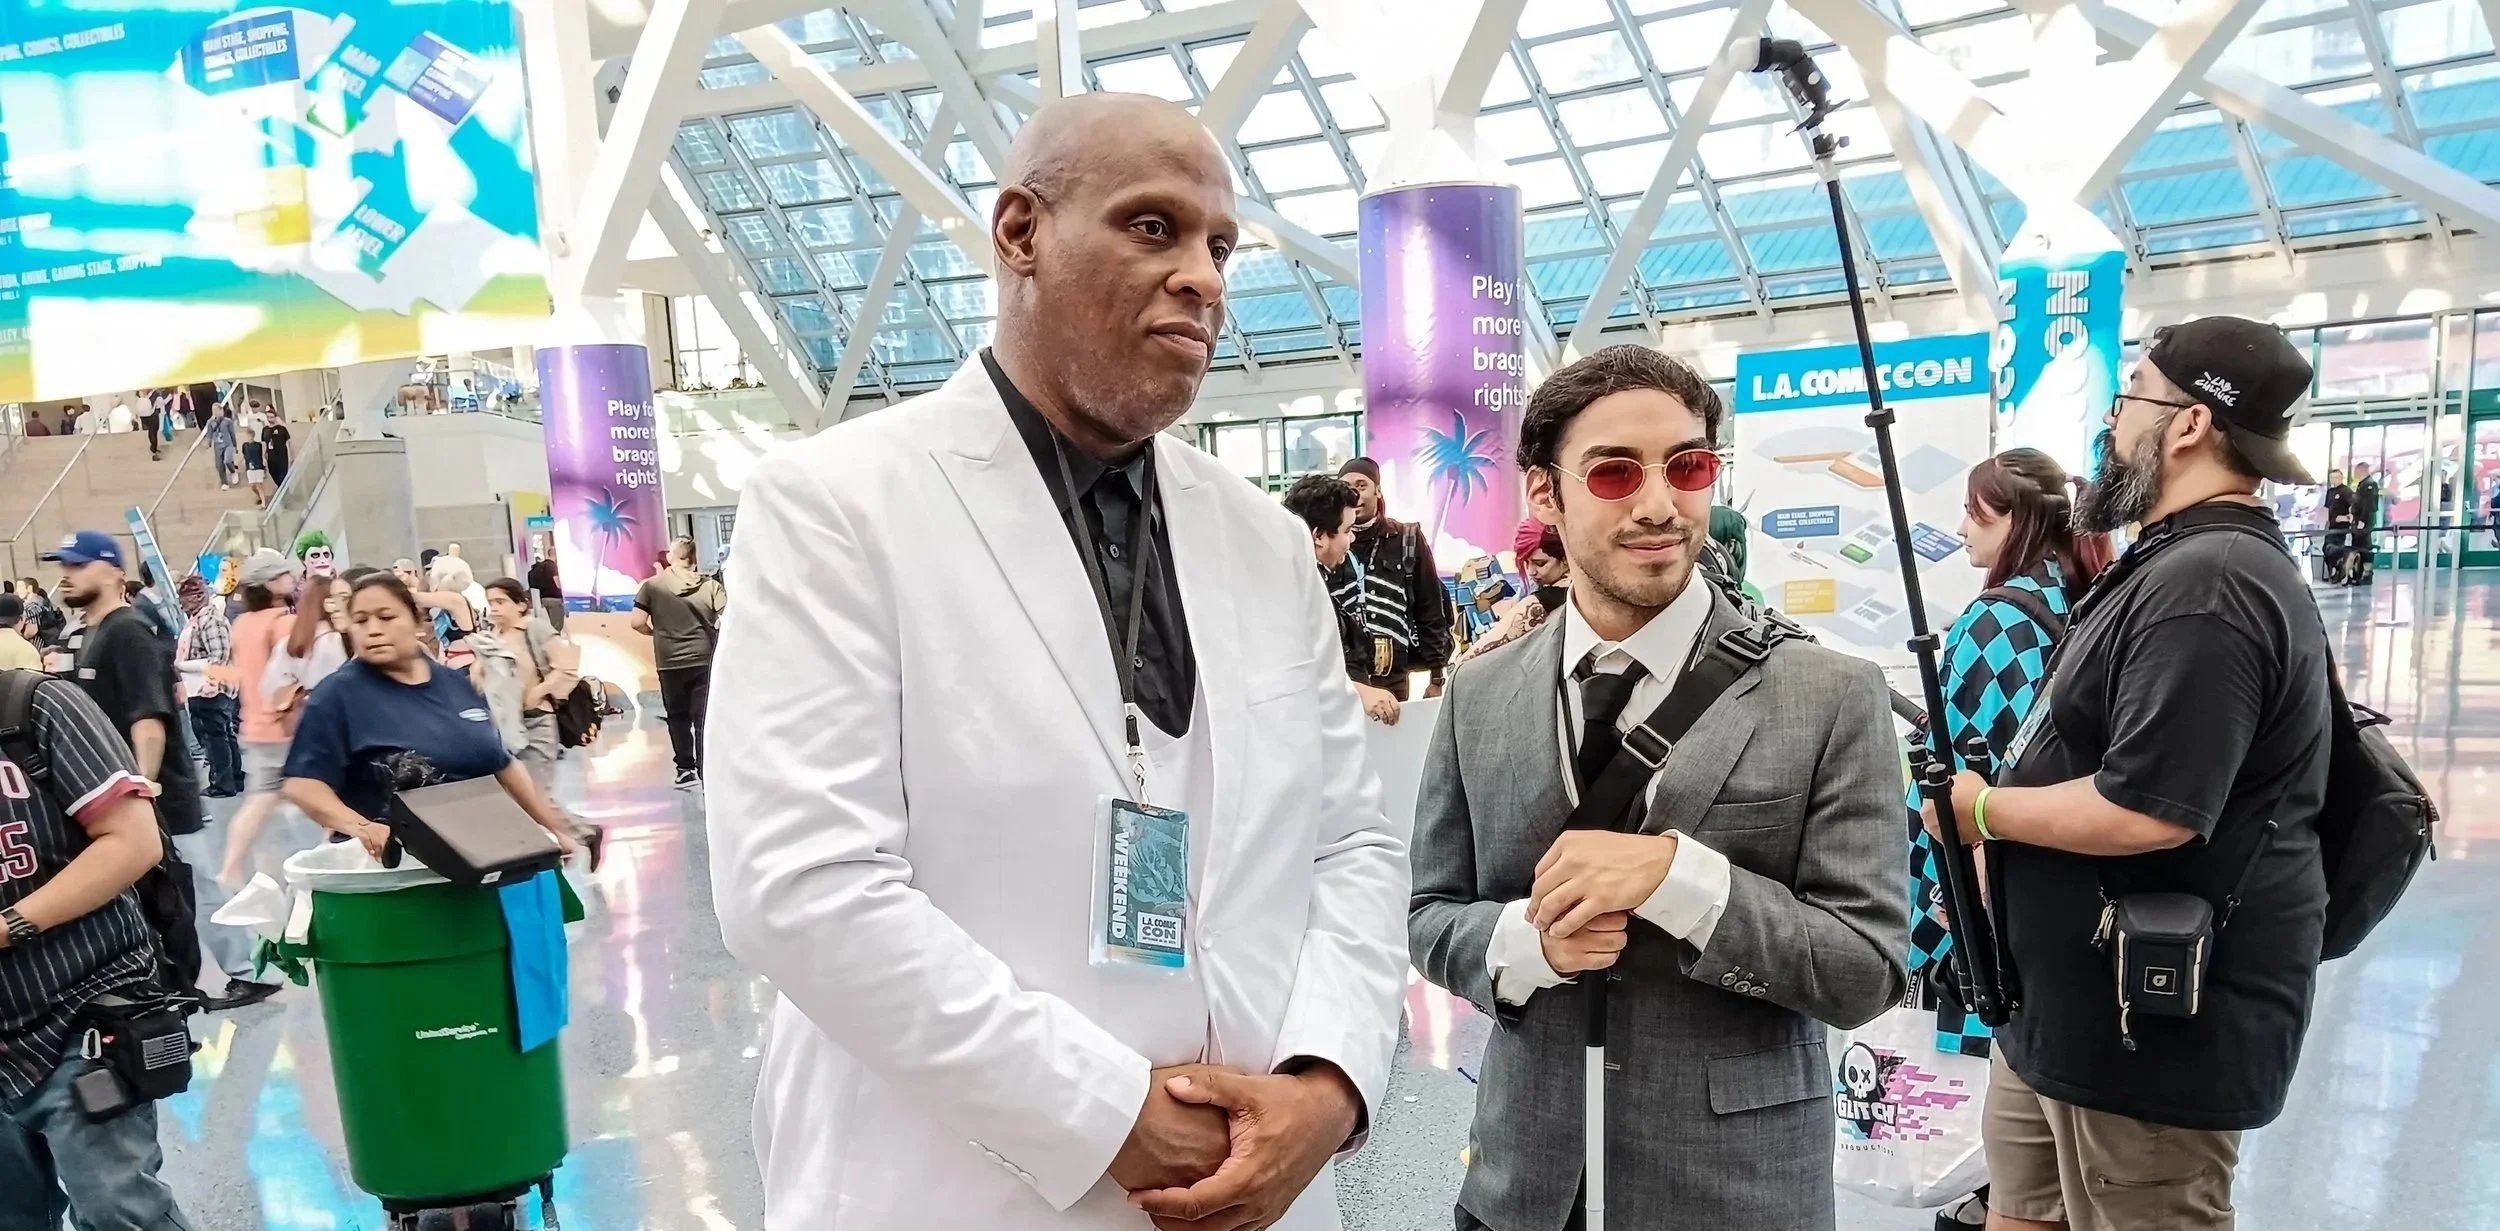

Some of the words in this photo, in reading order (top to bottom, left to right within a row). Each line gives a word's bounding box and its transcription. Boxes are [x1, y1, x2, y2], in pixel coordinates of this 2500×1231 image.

[1472, 275, 1513, 305] Play
[1472, 316, 1521, 336] more
[1753, 373, 1800, 401] L.A.
[1892, 357, 1972, 389] CON
[2194, 380, 2237, 407] CULTURE
[607, 400, 640, 420] Play
[610, 426, 649, 440] more
[1112, 832, 1129, 939] WEEKEND
[1142, 925, 1176, 940] CON
[1837, 1093, 1895, 1124] GLITCH
